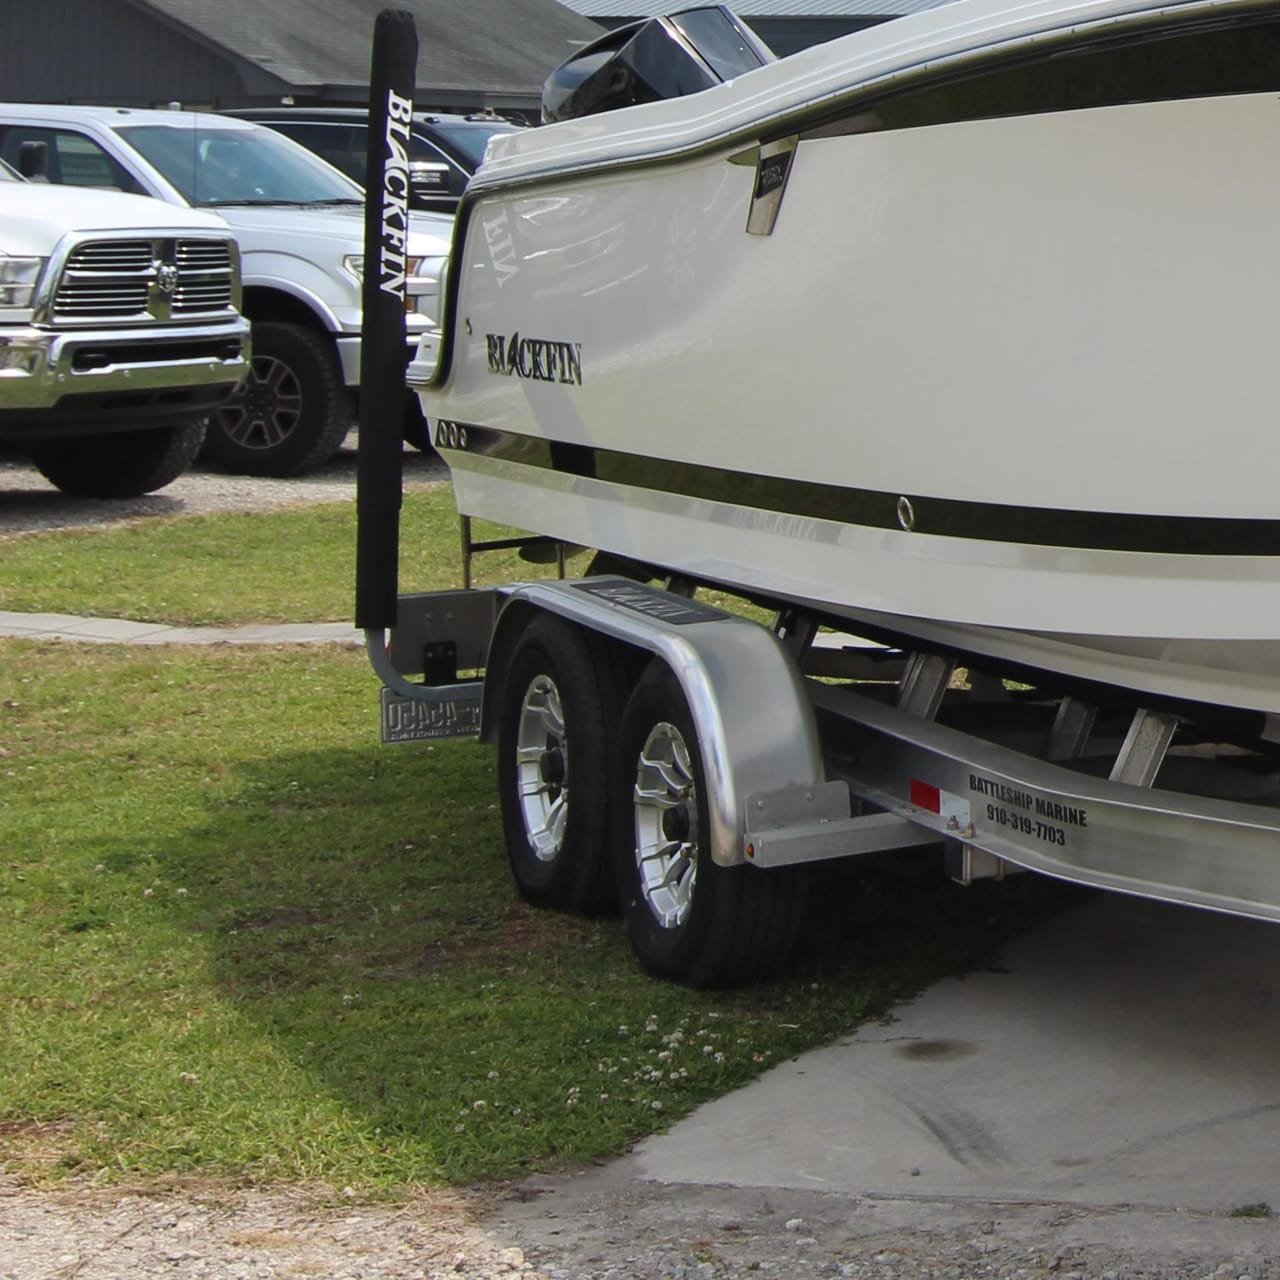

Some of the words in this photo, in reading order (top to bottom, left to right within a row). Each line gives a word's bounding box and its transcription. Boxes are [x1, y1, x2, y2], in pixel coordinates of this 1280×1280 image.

[379, 88, 413, 302] BLACKFIN
[485, 331, 583, 386] BLACKFIN
[968, 773, 1034, 810] BATTLESHIP
[1035, 797, 1088, 828] MARINE
[986, 803, 1066, 847] 910-319-7703
